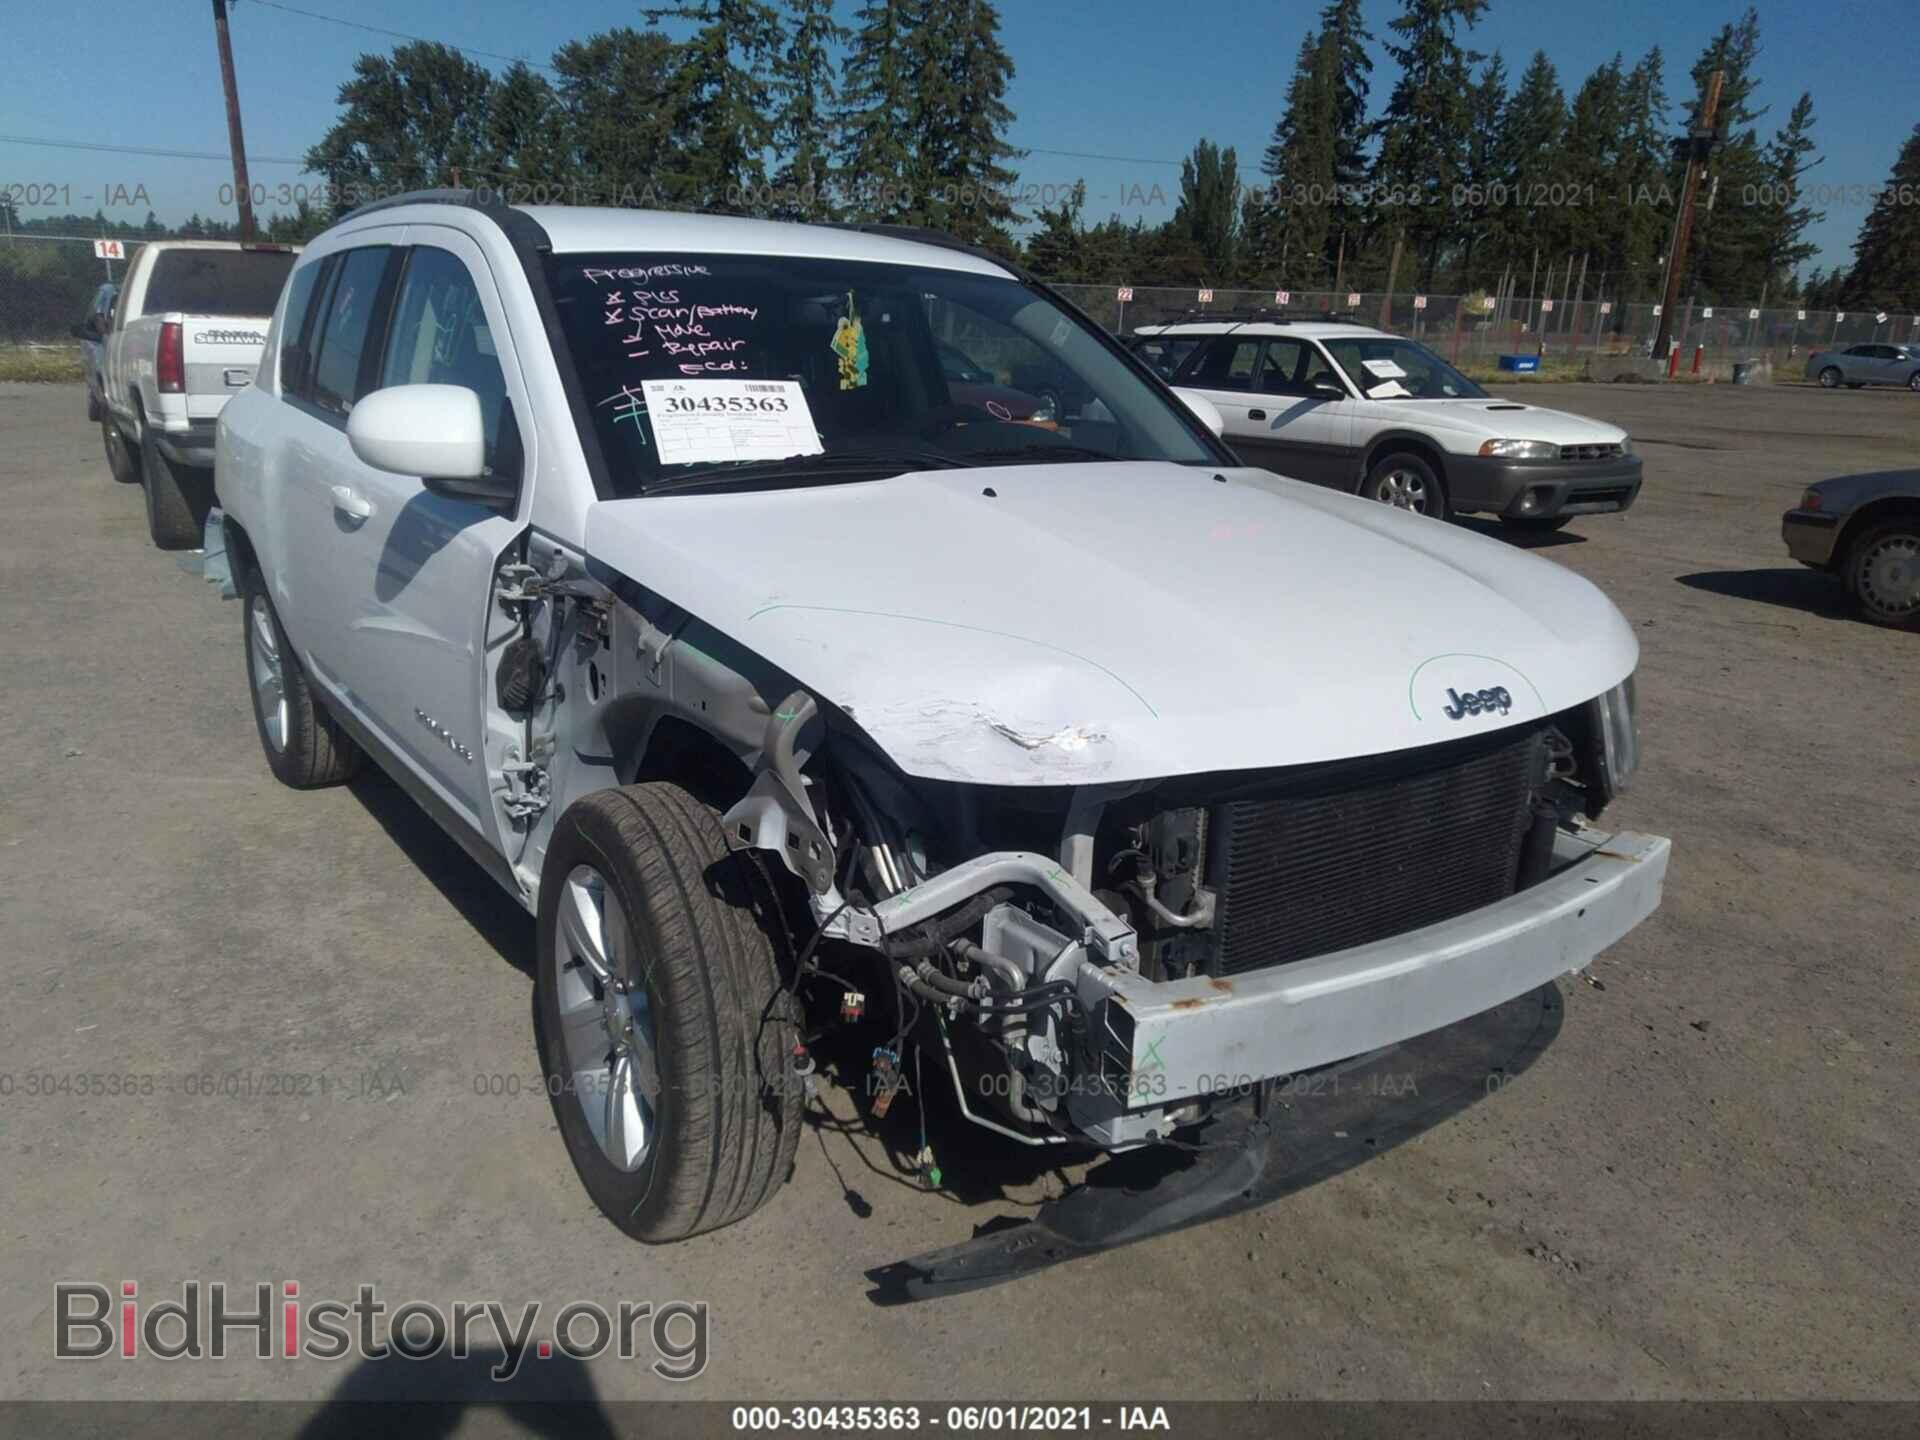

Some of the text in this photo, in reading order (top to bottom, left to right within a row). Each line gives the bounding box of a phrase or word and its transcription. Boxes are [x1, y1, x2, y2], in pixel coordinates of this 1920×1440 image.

[99, 242, 120, 256] 14
[665, 396, 789, 413] 30435363
[1443, 686, 1512, 720] Jeep
